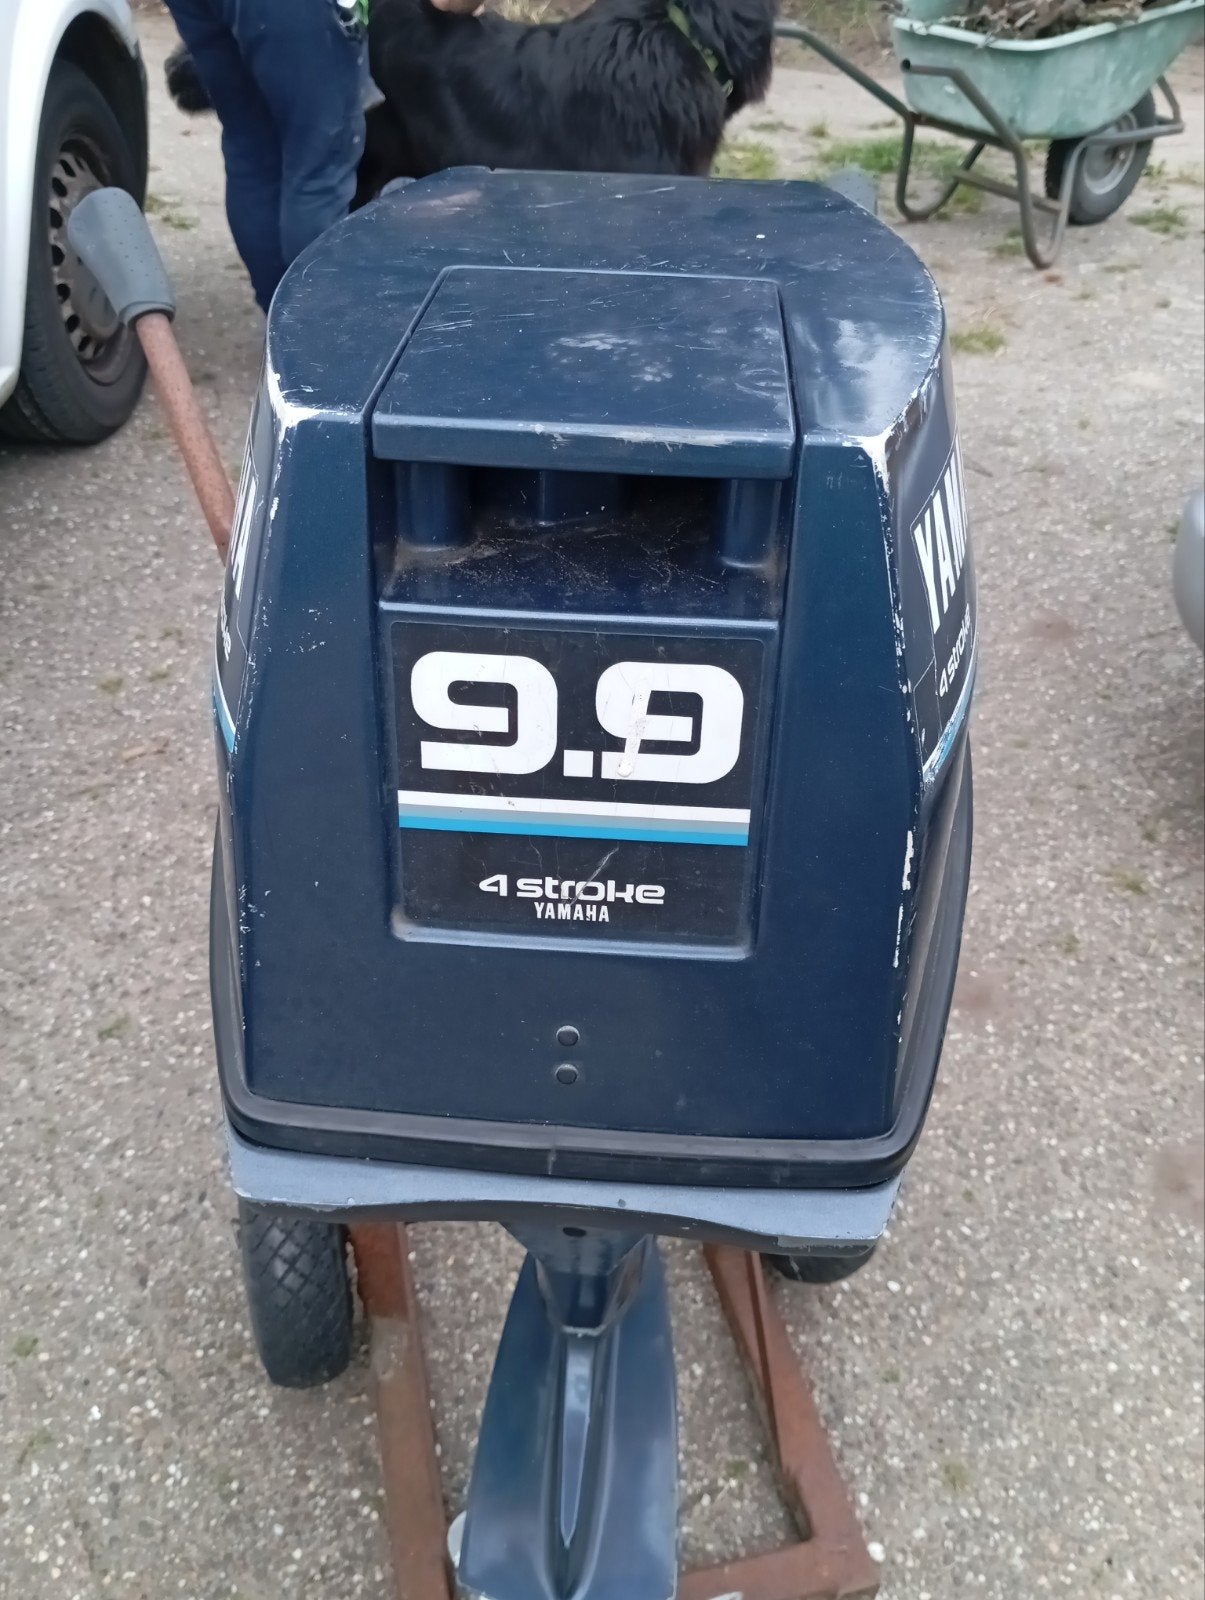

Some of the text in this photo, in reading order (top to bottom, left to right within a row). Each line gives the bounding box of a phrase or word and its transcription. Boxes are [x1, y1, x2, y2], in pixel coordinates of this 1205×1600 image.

[939, 603, 970, 697] 4 stroke
[410, 651, 745, 784] 9.9
[478, 873, 666, 905] 4 stroke
[534, 901, 610, 923] YAMAHA
